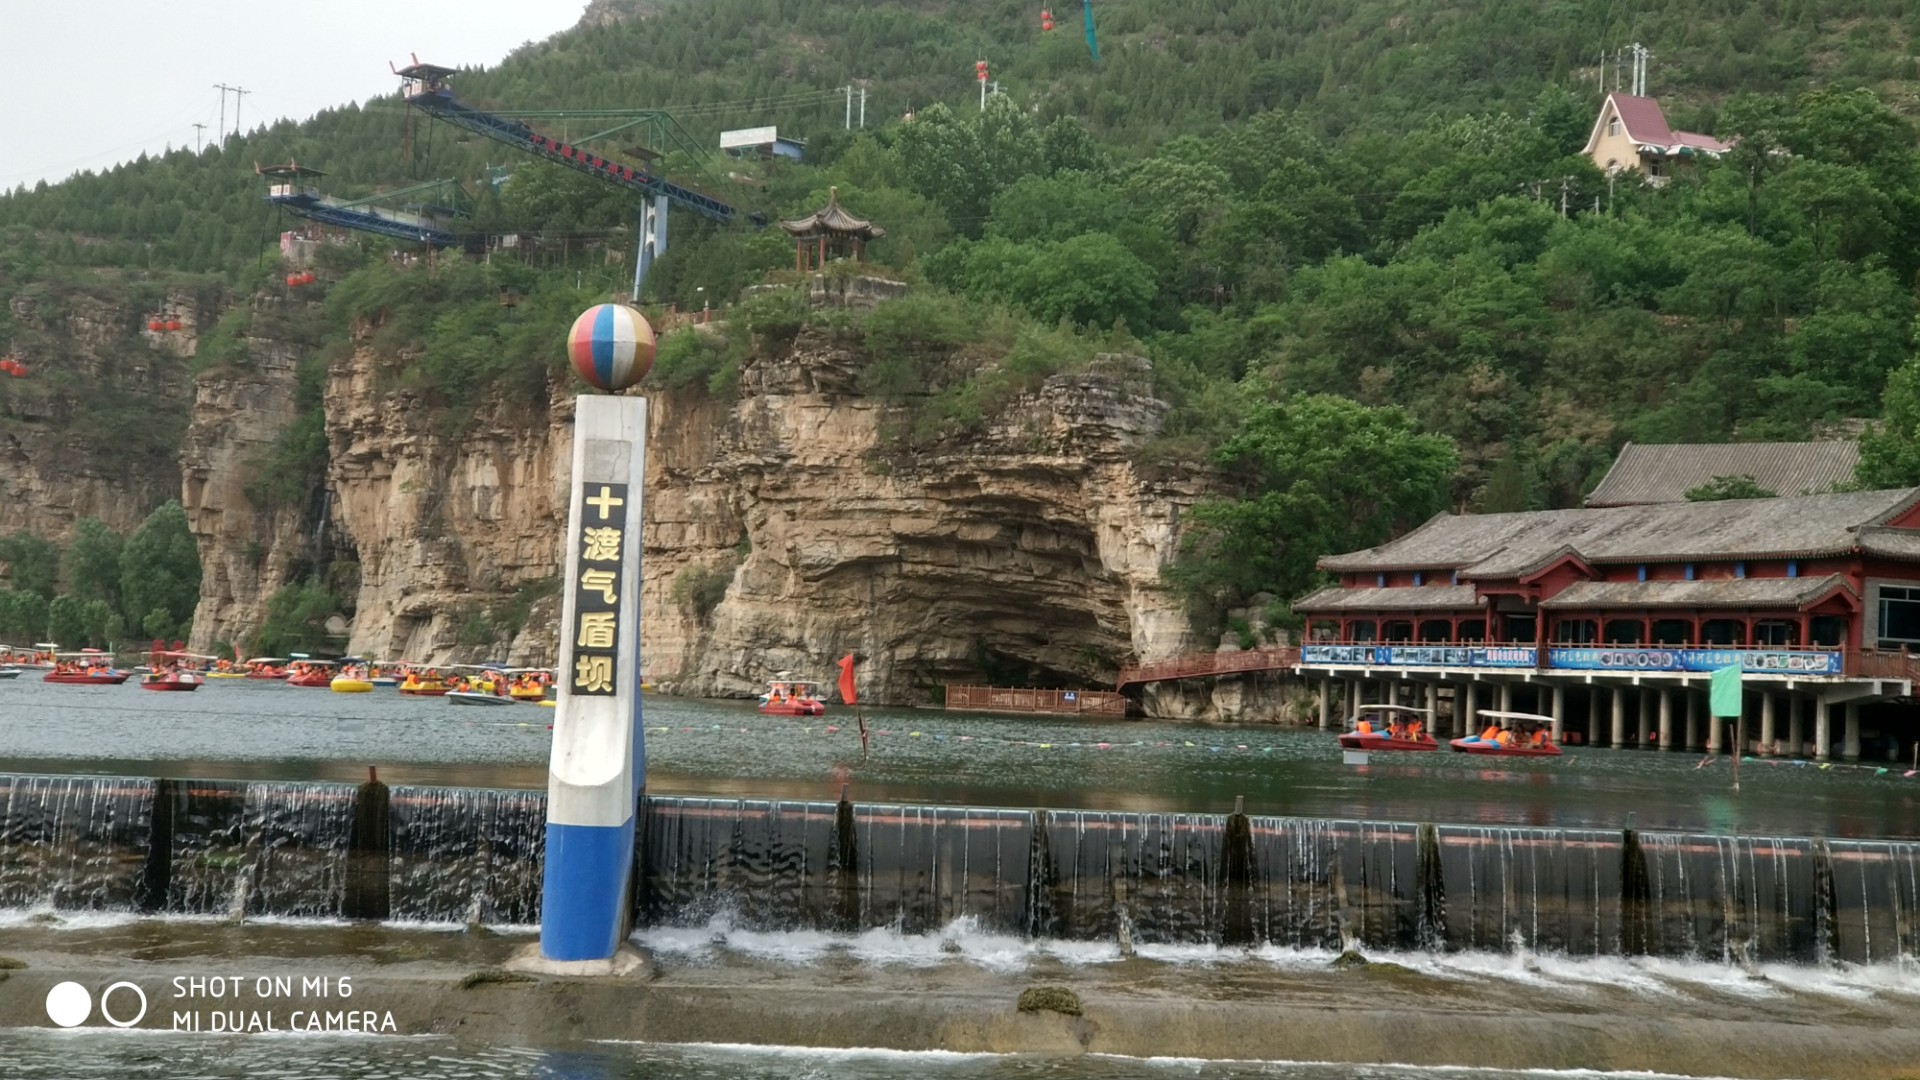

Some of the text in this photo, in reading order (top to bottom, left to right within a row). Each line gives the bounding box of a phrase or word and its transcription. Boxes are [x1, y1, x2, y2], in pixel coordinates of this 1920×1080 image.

[575, 486, 624, 693] 十渡气盾坝
